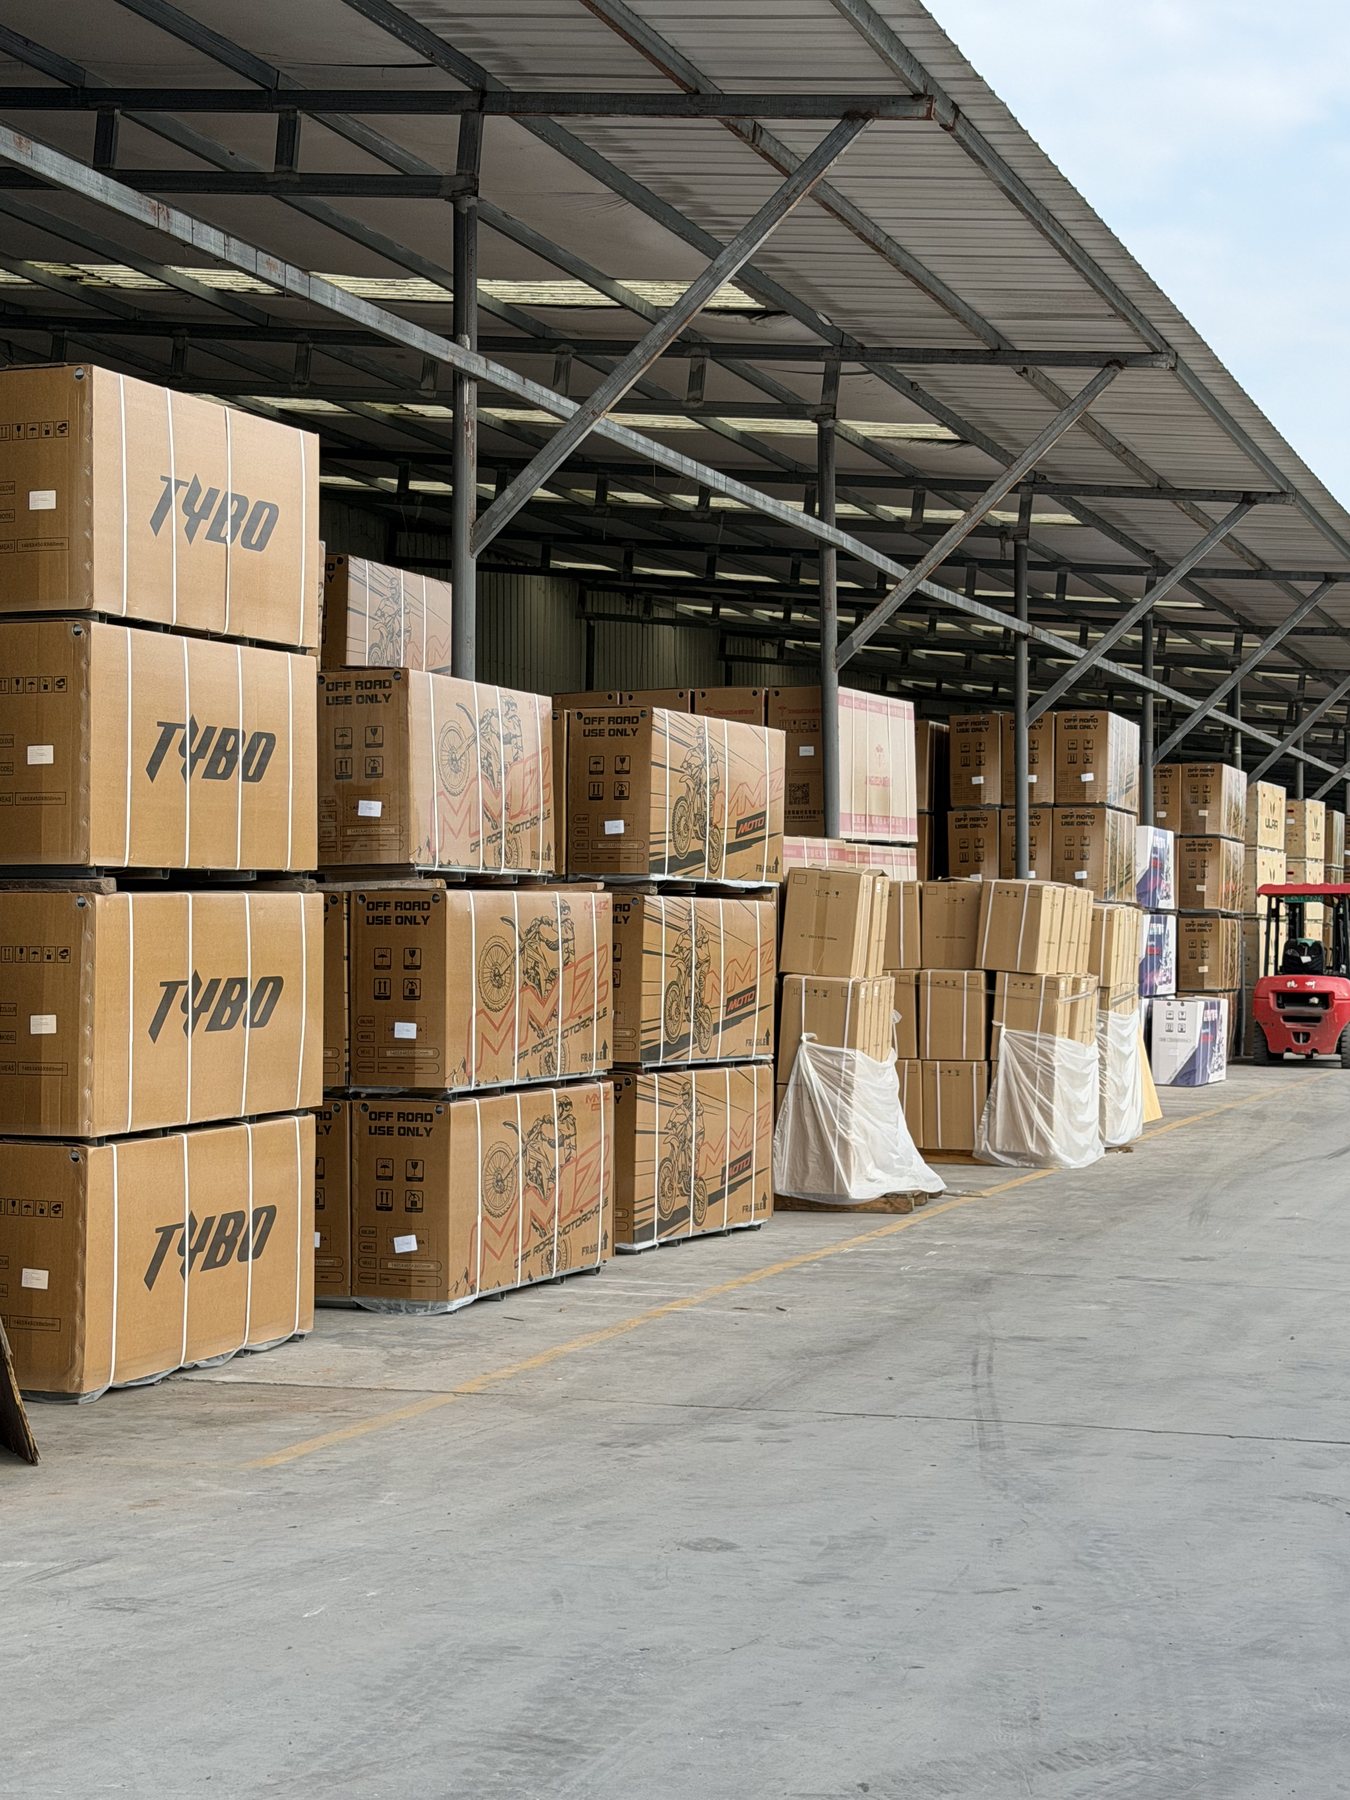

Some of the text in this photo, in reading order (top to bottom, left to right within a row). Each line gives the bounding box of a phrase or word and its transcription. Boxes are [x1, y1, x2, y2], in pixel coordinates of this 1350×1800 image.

[150, 473, 279, 552] TYBO
[326, 679, 392, 691] OFF ROAD
[326, 693, 392, 705] USE ONLY
[583, 716, 639, 725] OFF ROAD
[583, 728, 638, 737] USE ONLY
[146, 714, 276, 783] TYBO
[737, 817, 764, 835] MOTO
[366, 901, 431, 911] OFF ROAD
[366, 915, 431, 925] USE ONLY
[148, 969, 284, 1044] TYBO
[728, 991, 755, 1012] MOTO
[369, 1111, 434, 1123] OFF ROAD
[368, 1126, 433, 1137] USE ONLY
[144, 1205, 277, 1291] TYBO
